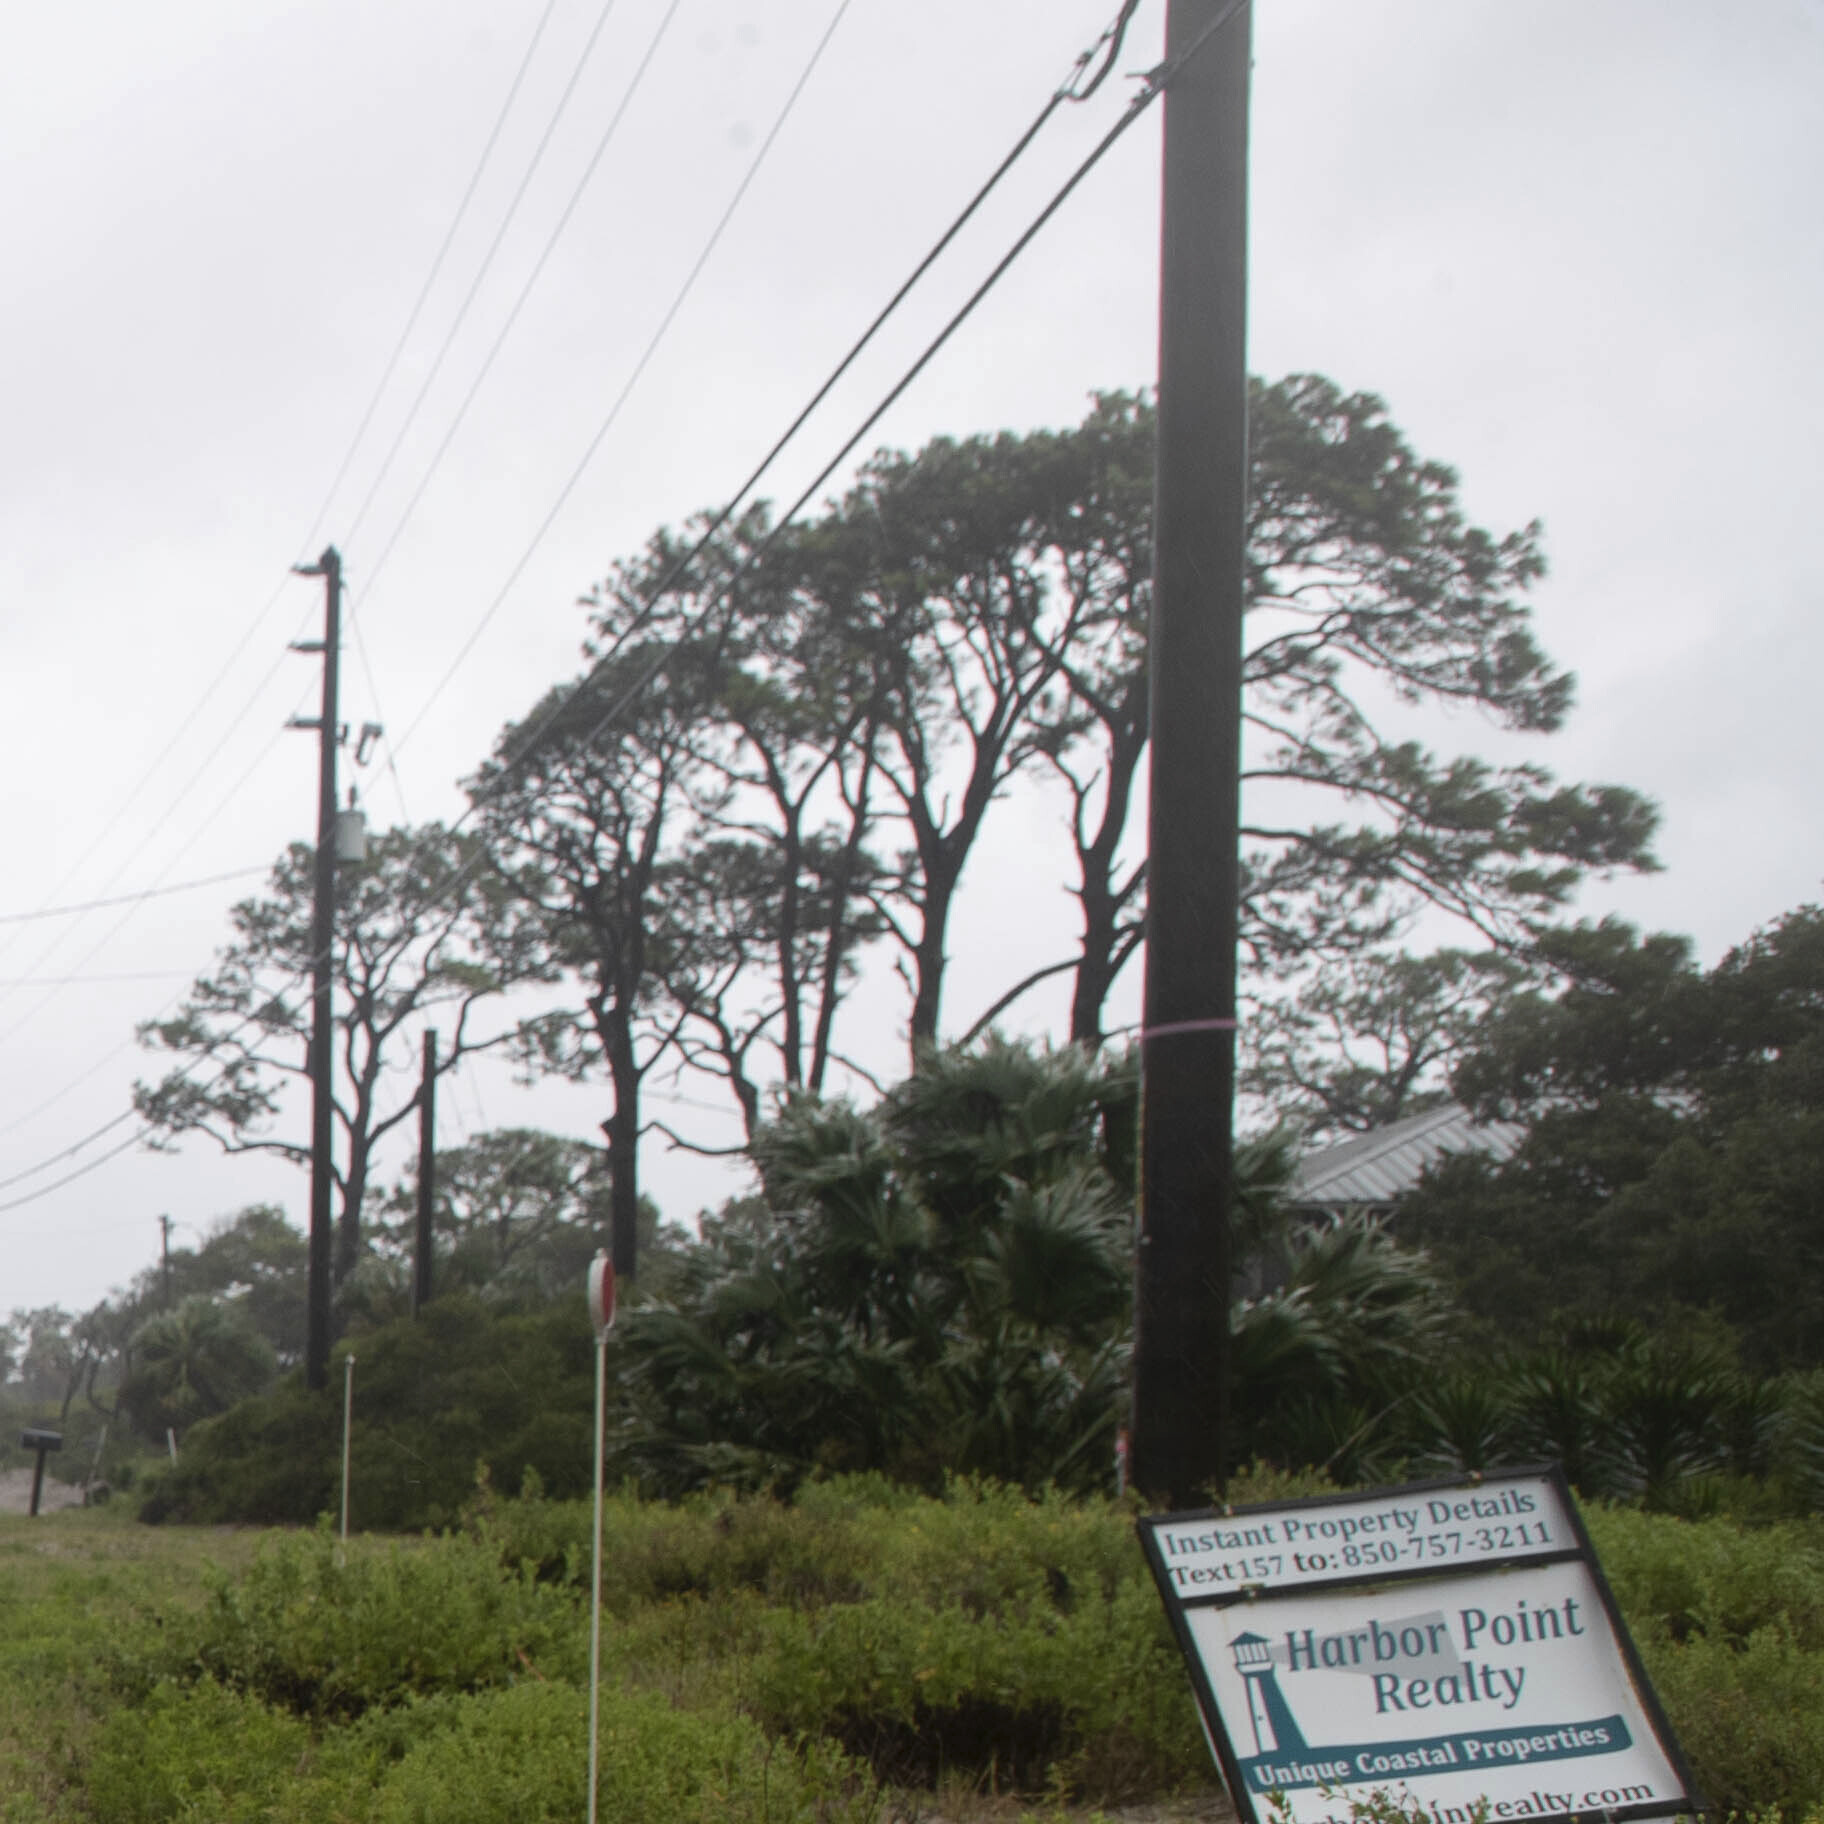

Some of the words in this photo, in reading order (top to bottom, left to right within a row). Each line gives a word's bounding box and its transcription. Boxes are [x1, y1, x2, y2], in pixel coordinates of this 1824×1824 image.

[1165, 1522, 1277, 1555] Instant
[1282, 1508, 1419, 1542] Property
[1426, 1489, 1536, 1525] Details
[1342, 1521, 1552, 1567] 850-757-3211
[1285, 1619, 1447, 1672] Harbor
[1459, 1598, 1585, 1650] Point
[1372, 1661, 1525, 1714] Realty
[1253, 1758, 1350, 1786] Unique
[1355, 1744, 1458, 1775] Coastal
[1462, 1725, 1610, 1761] Properties
